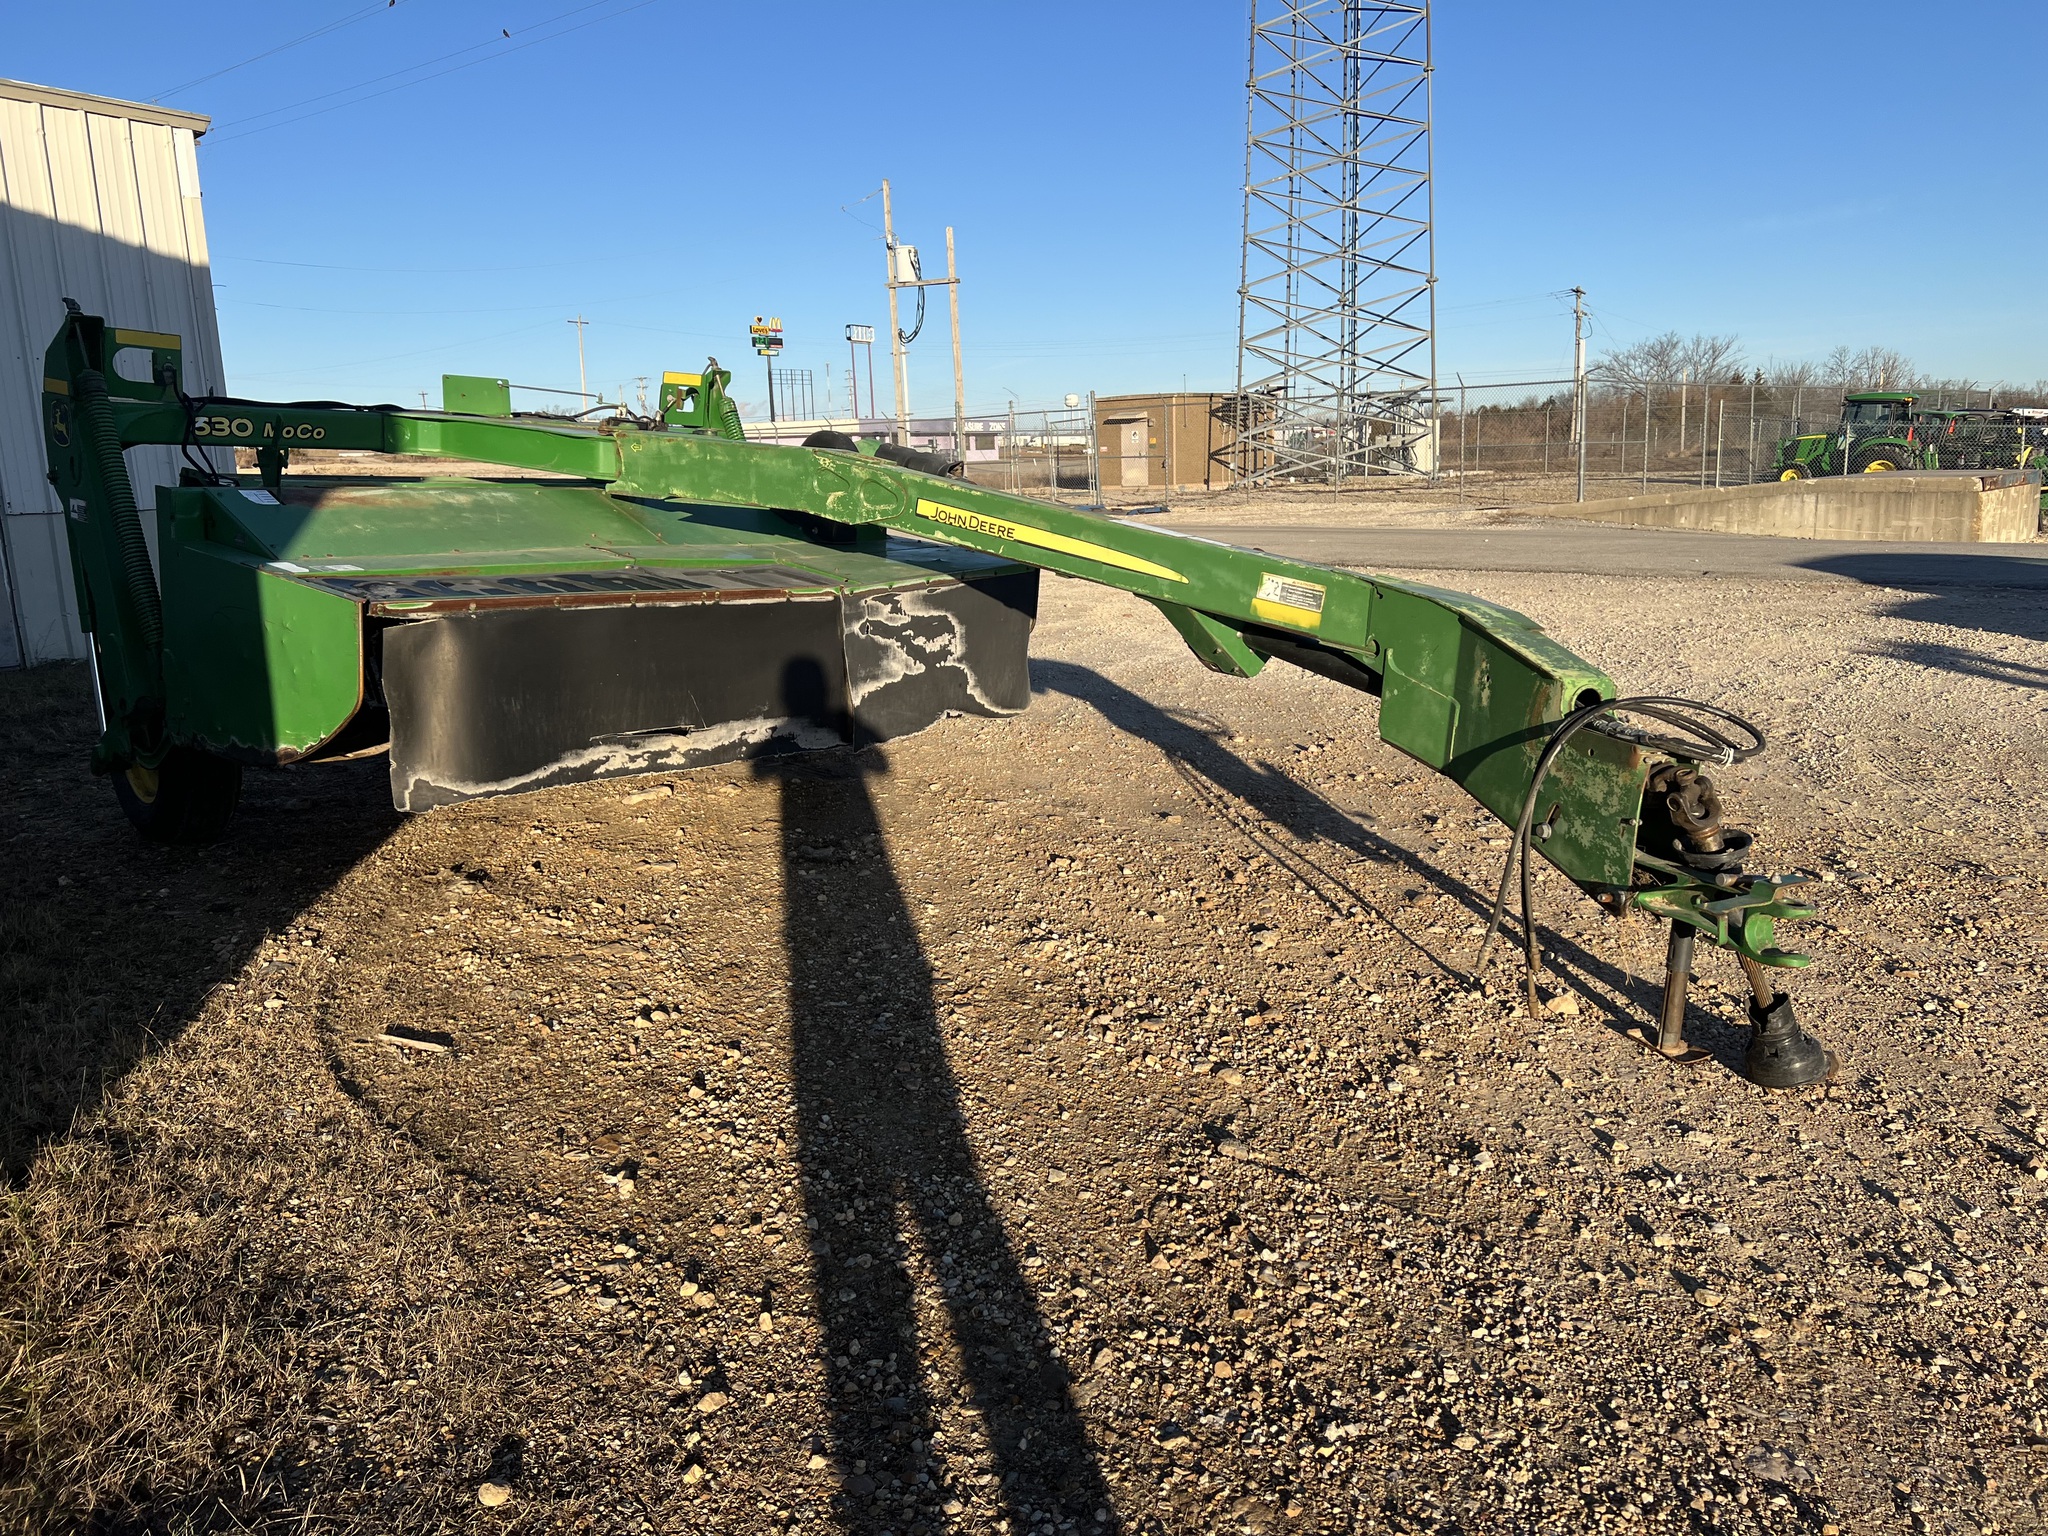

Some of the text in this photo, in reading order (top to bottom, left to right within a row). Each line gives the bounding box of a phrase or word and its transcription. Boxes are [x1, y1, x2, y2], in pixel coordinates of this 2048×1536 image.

[263, 422, 326, 439] MoCo
[988, 421, 1006, 432] ZONE
[930, 506, 1016, 539] JOHN DEERE
